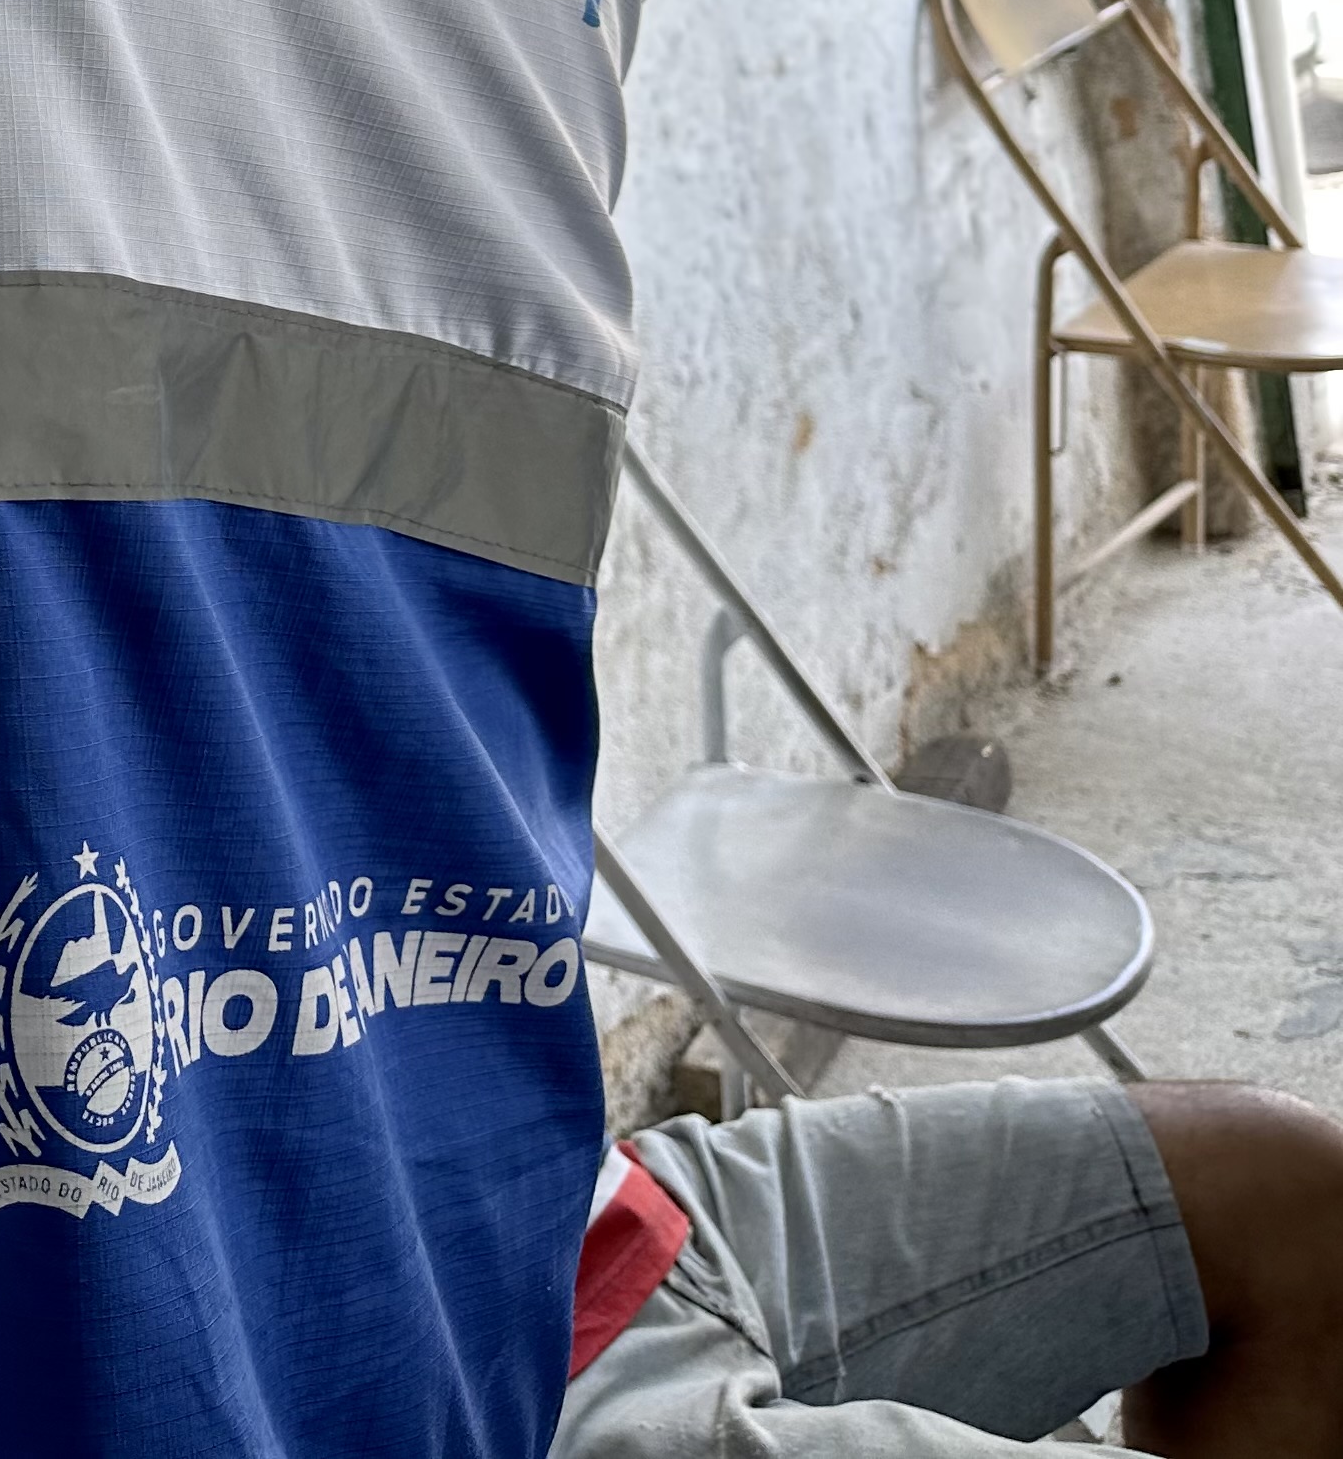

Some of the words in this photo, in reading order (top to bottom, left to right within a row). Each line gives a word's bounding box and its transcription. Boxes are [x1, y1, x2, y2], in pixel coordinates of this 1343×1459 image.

[153, 889, 335, 958] GOVERN
[328, 876, 373, 925] DO
[162, 969, 278, 1077] RIO
[292, 954, 362, 1056] DE
[343, 930, 579, 1035] ANEIRO
[58, 1182, 83, 1203] DO
[96, 1175, 120, 1201] RIO
[129, 1171, 144, 1191] DE
